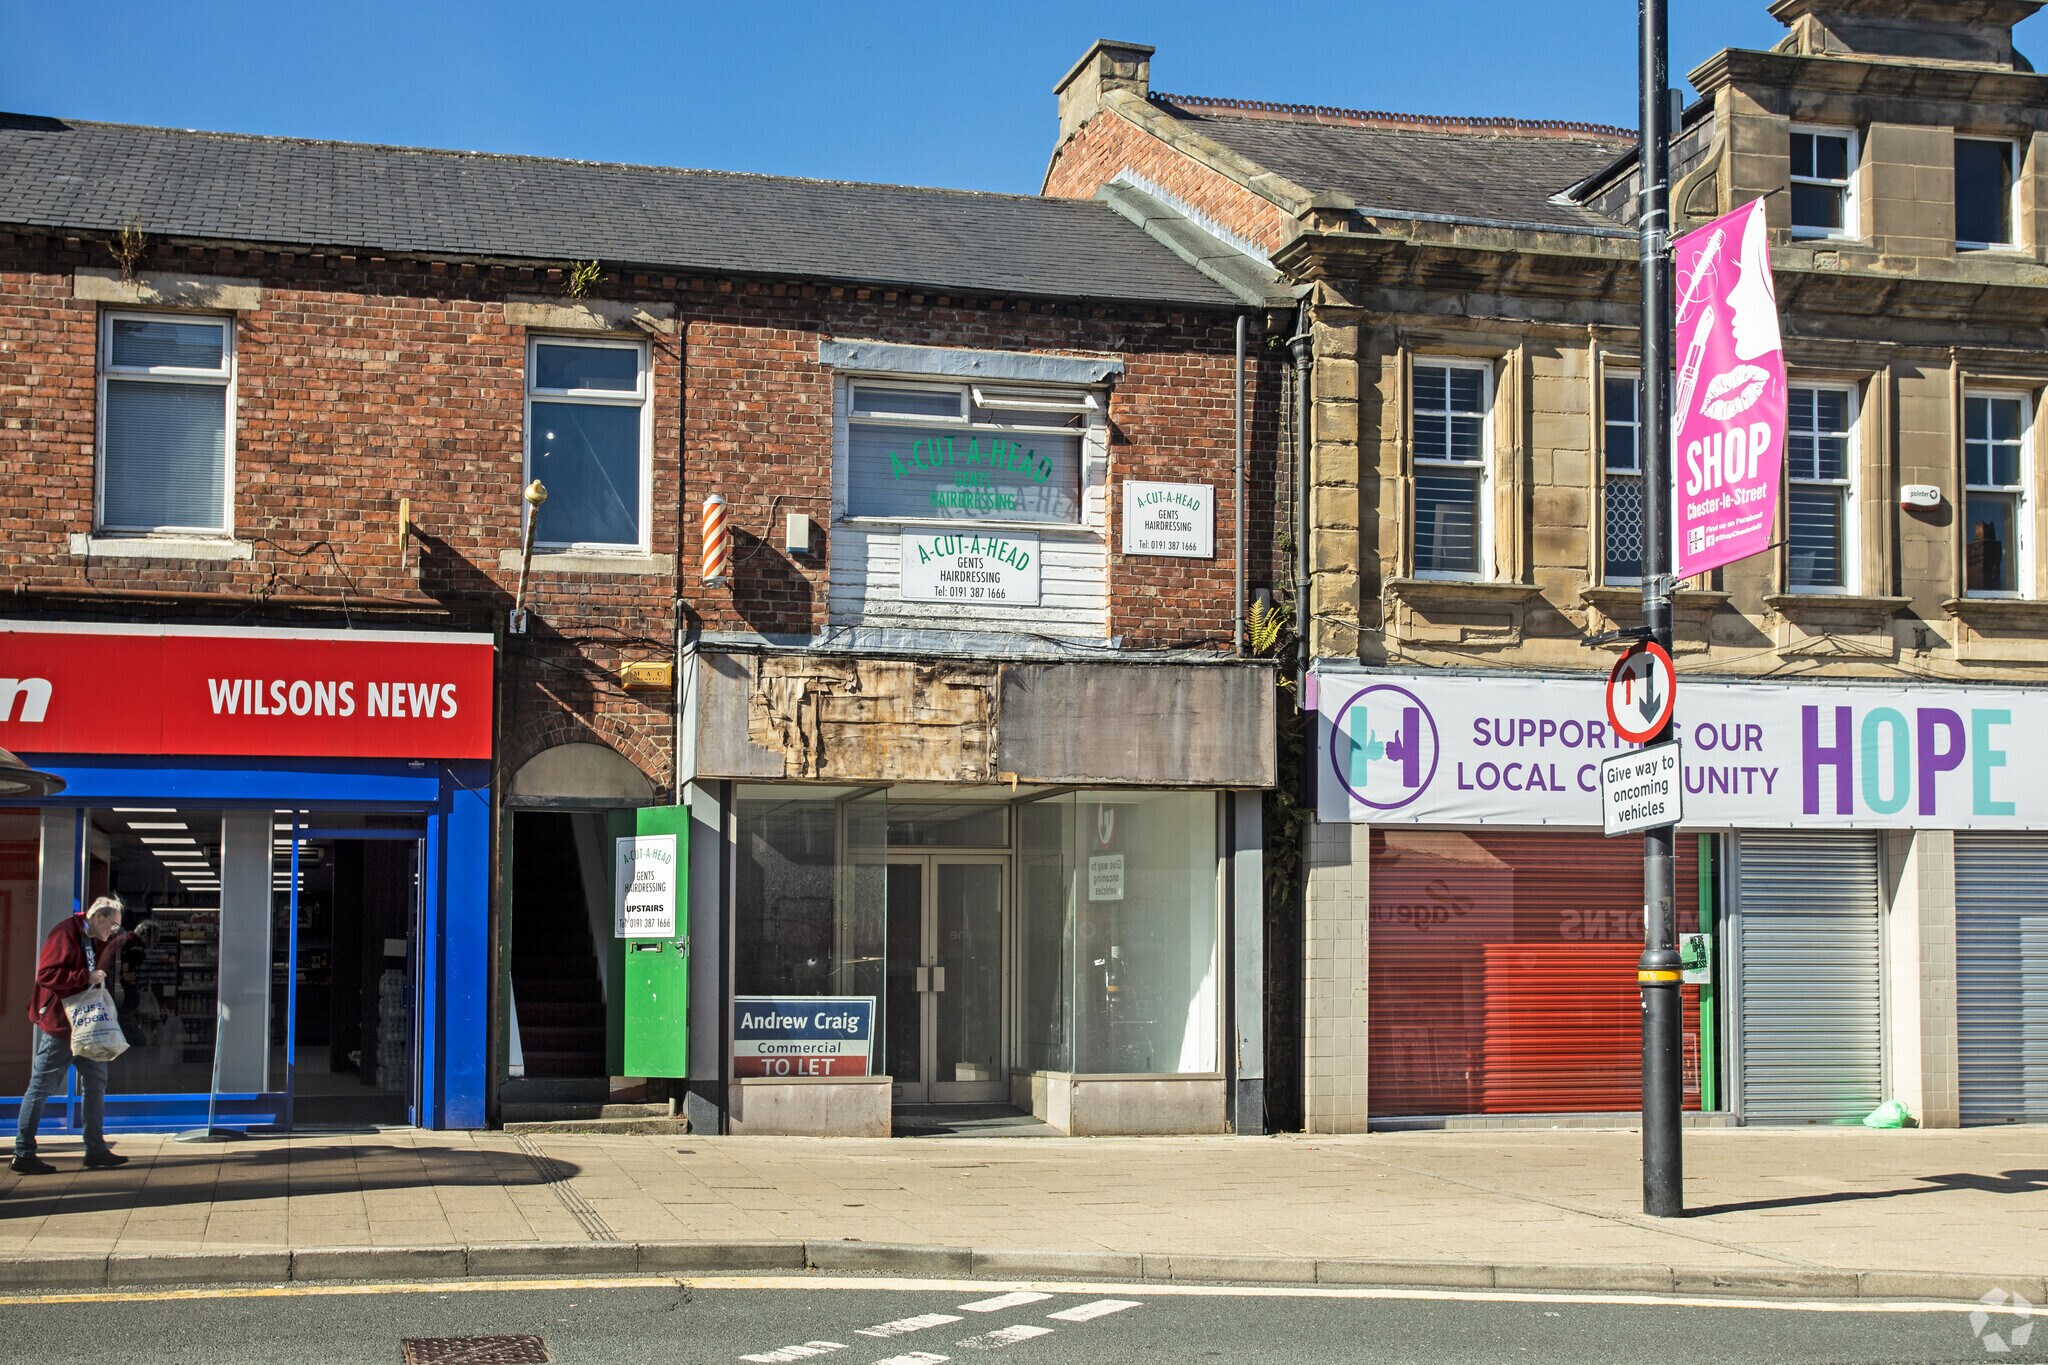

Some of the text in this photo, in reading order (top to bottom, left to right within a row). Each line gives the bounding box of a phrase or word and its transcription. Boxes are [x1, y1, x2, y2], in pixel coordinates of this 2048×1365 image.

[889, 435, 1053, 484] A-CUT-A-HEAD
[1686, 421, 1771, 497] SHOP
[954, 471, 991, 489] GENTS
[929, 491, 1016, 511] HAIRDRESSING
[1137, 491, 1200, 511] A-CUT-A-HEAD
[1687, 482, 1767, 521] Chester-le-Street
[1158, 509, 1179, 520] GENTS
[1705, 524, 1719, 534] Find
[1727, 520, 1735, 528] on
[1736, 511, 1764, 526] Facebook
[1144, 520, 1192, 532] HAIRDRESSING
[918, 533, 1030, 571] A-CUT-A-HEAD
[1139, 539, 1197, 551] Tel: 0191 387 1666
[957, 556, 984, 569] GENTS
[940, 570, 1001, 584] HAIRDRESSING
[934, 586, 1006, 599] Tel: 0191 387 1666
[208, 678, 458, 719] WILSONS NEWS
[1473, 716, 1763, 752] SUPPORT OUR
[1607, 755, 1675, 784] Give way to
[1802, 705, 2016, 816] HOPE
[1457, 762, 1779, 795] LOCAL CUNITY
[1613, 779, 1669, 803] oncoming
[1618, 801, 1665, 822] vehicles
[623, 847, 672, 865] A-CUT-A-HEAD
[636, 871, 655, 881] GENTS
[624, 882, 667, 893] HAIRDRESSING
[626, 904, 664, 913] UPSTAIRS
[629, 918, 643, 928] 0191
[644, 918, 655, 928] 387
[657, 918, 671, 928] 1666
[740, 1011, 860, 1033] Andrew Craig
[757, 1042, 841, 1054] Commercial
[761, 1058, 836, 1076] TO LET
